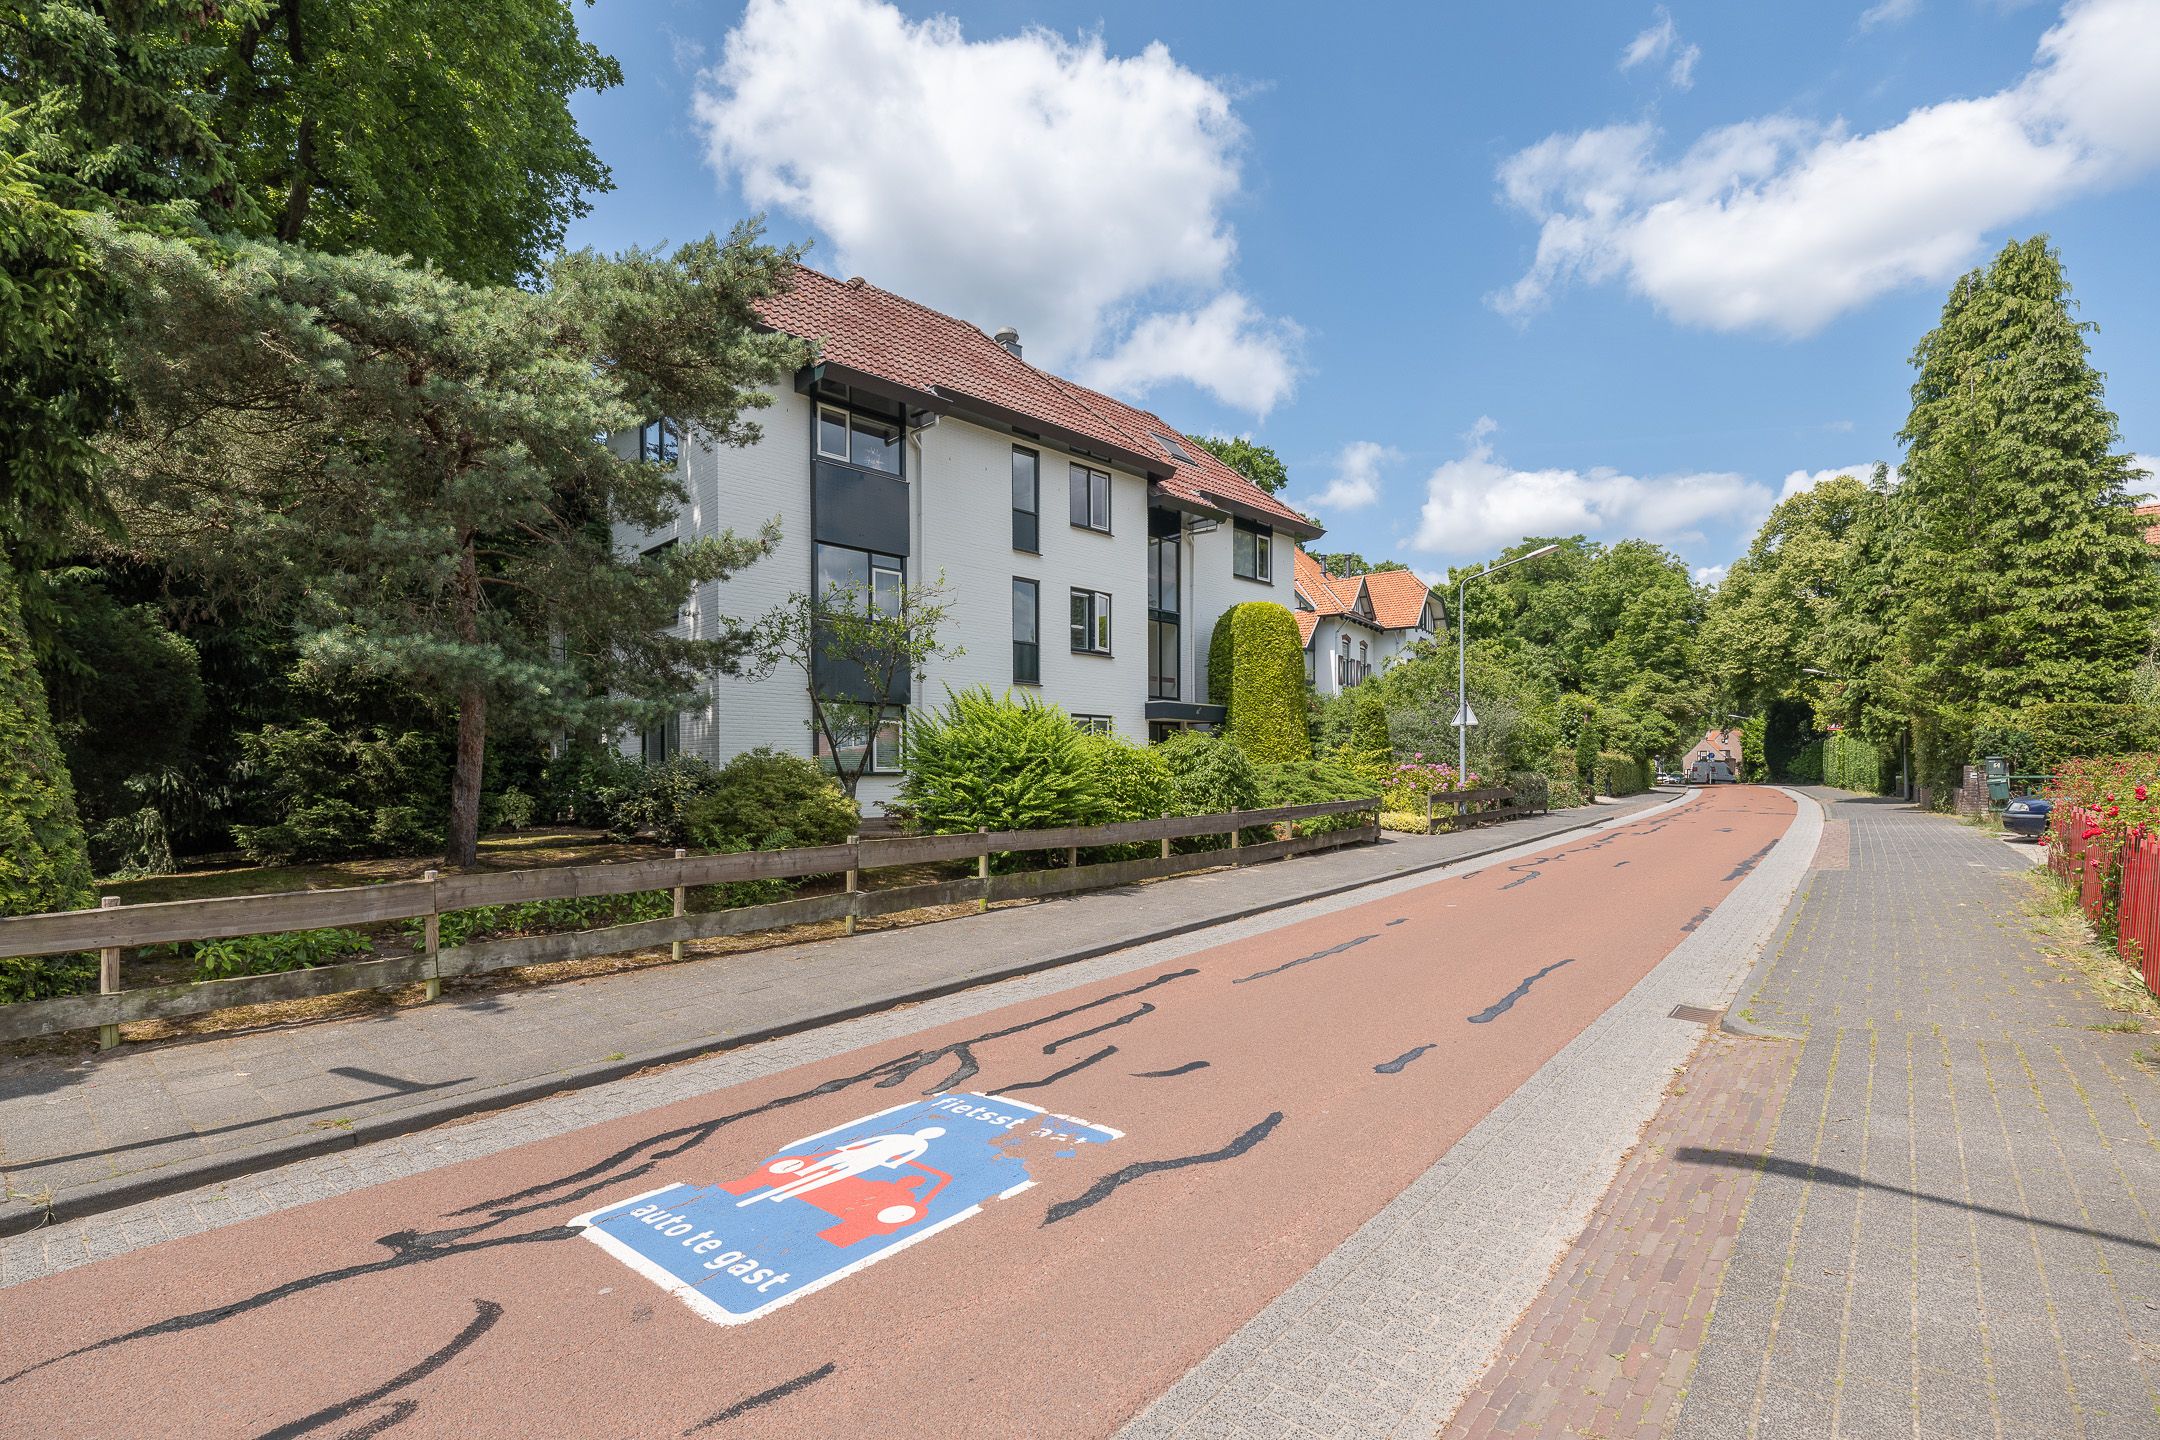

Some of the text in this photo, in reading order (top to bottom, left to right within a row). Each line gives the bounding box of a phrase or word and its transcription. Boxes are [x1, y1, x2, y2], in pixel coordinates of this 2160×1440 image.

[630, 1204, 791, 1293] auto te gast
